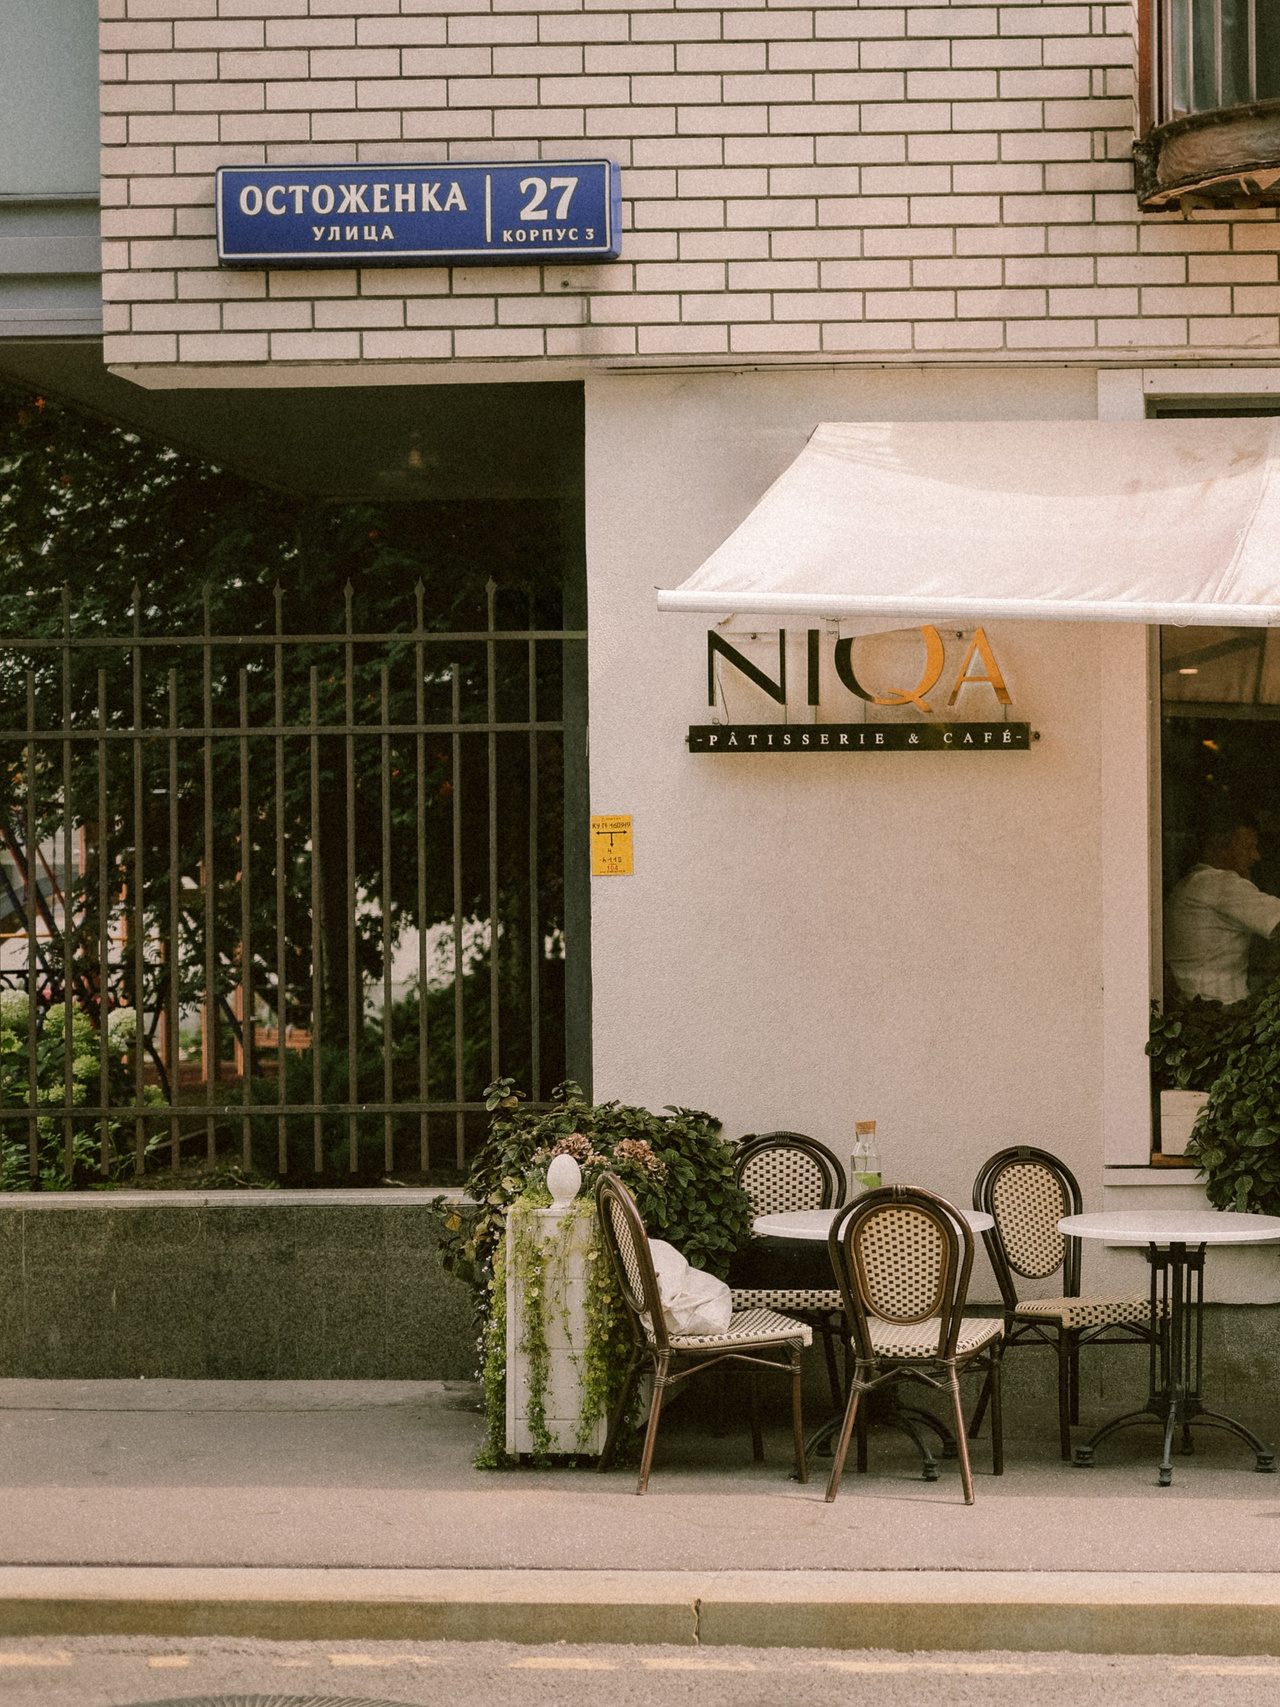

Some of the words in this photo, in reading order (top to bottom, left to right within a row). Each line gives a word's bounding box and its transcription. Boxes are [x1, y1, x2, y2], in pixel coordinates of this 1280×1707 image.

[238, 181, 468, 216] ОСТОЖЕНКА
[518, 176, 579, 221] 27
[312, 224, 395, 242] УЛИЦА
[502, 228, 579, 243] КОРПУС
[584, 228, 595, 241] 3
[707, 624, 1013, 713] NIQA
[908, 733, 920, 745] &
